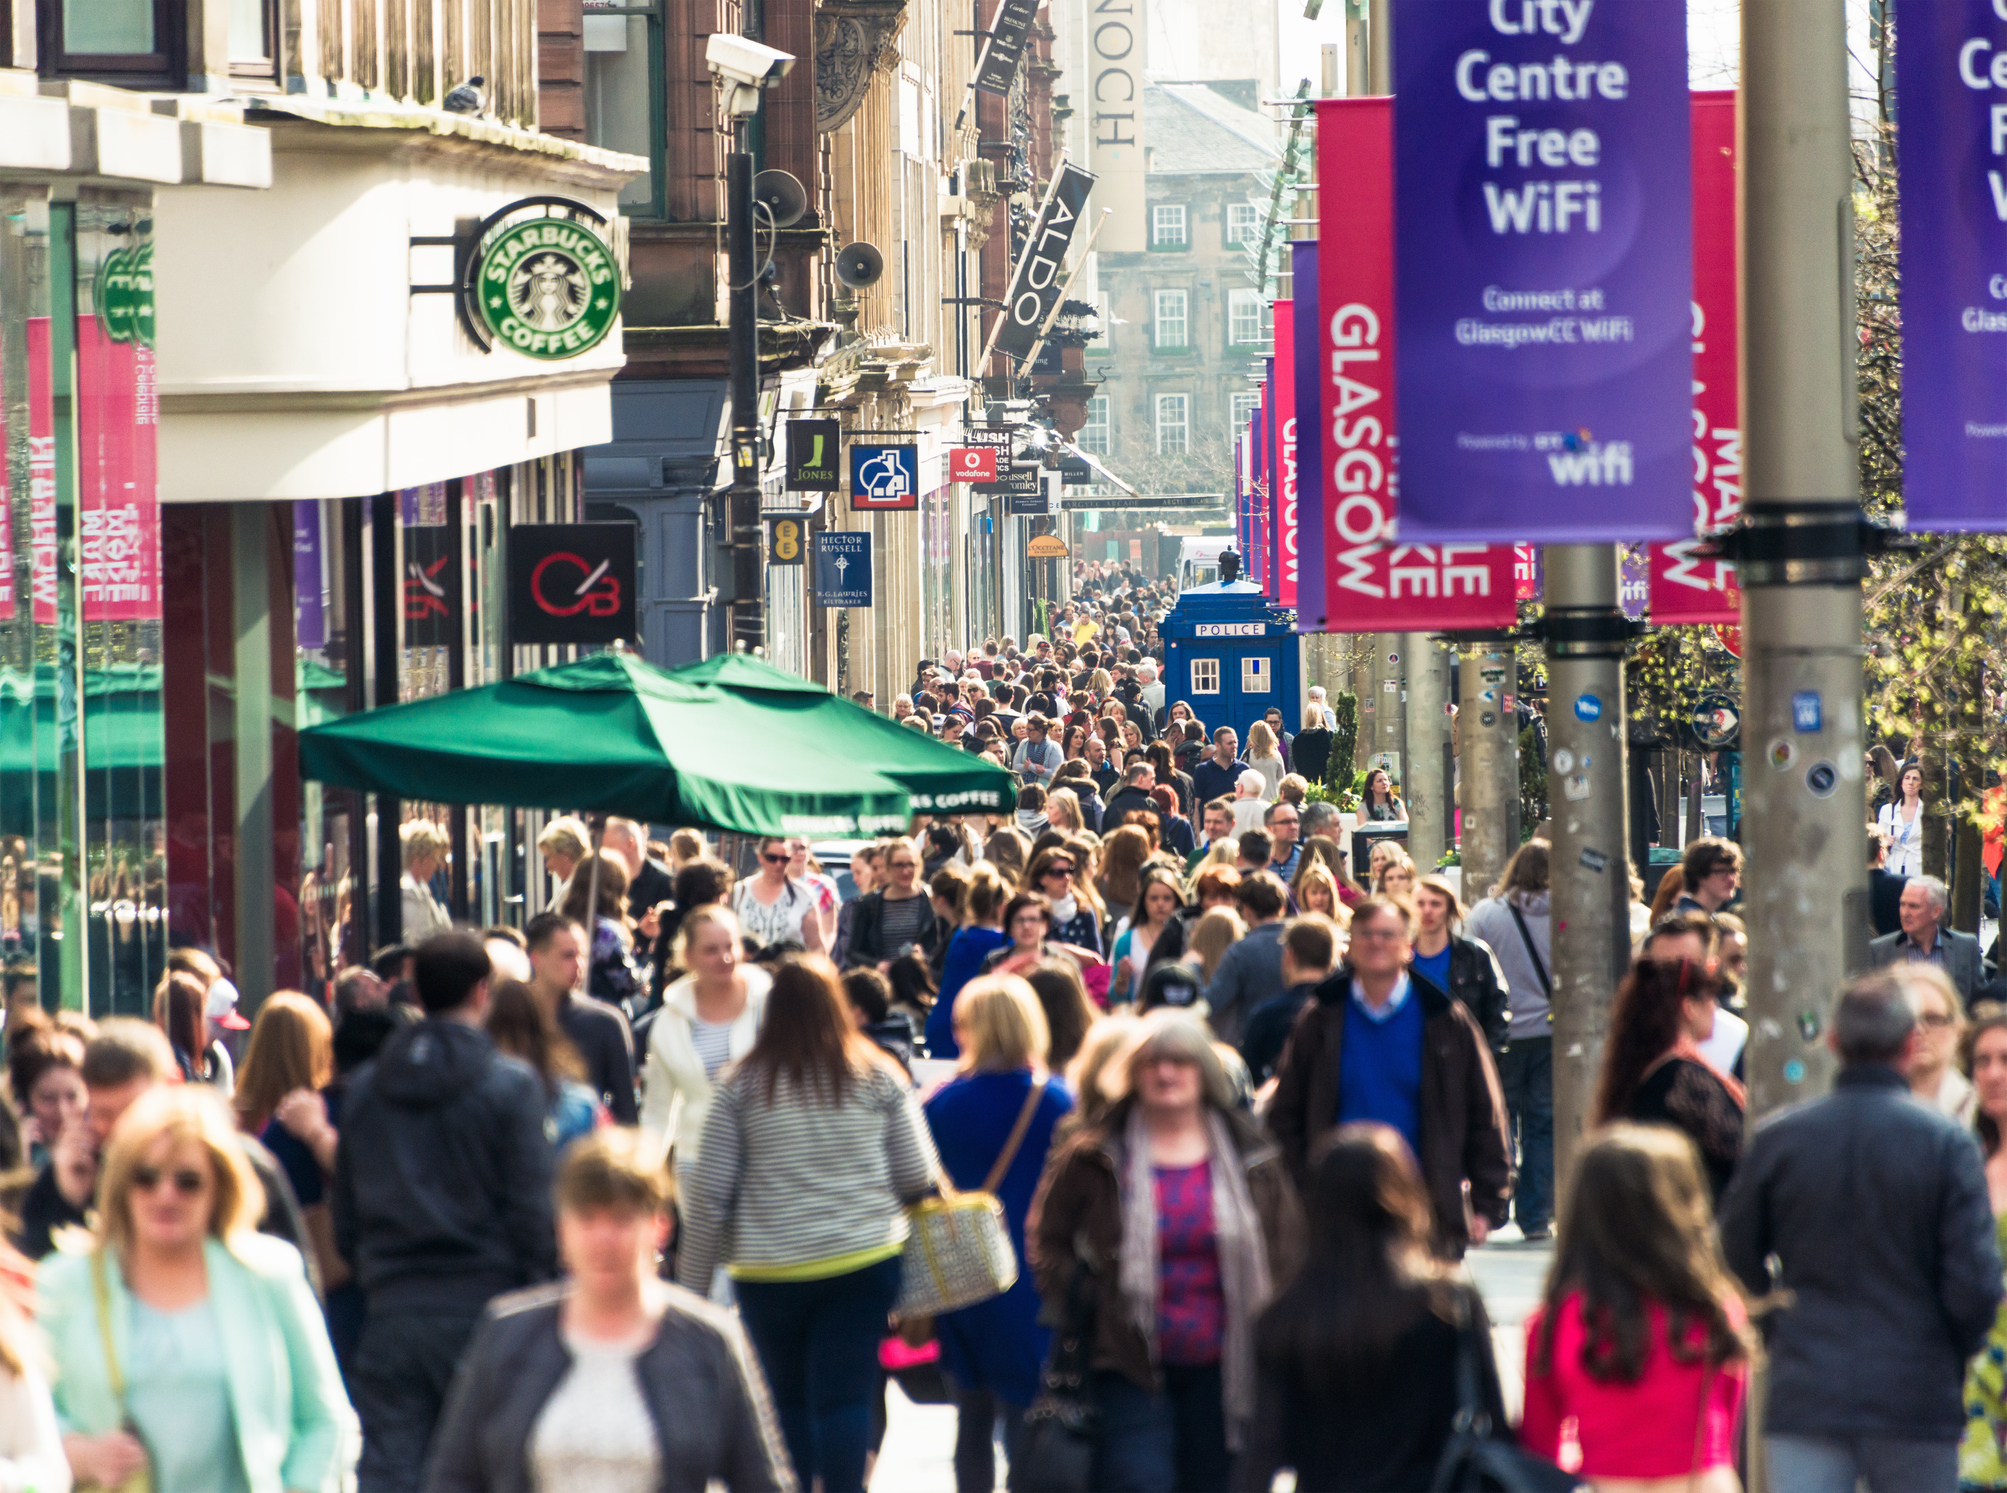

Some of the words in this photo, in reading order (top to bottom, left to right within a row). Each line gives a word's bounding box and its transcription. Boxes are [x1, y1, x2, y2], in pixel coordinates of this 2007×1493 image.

[1488, 0, 1595, 43] City
[1456, 49, 1629, 101] Centre
[1486, 115, 1600, 167] Free
[1482, 181, 1602, 234] WiFi
[486, 226, 612, 285] STARBUCKS
[1015, 195, 1074, 326] ALDO
[1482, 285, 1575, 312] Connect
[1578, 287, 1605, 311] at
[500, 316, 596, 353] COFFEE
[967, 432, 1009, 444] LUSH
[1331, 303, 1386, 599] GLASGOW
[793, 468, 833, 481] JONES
[1008, 472, 1032, 481] ussell
[1547, 440, 1634, 486] wifi
[821, 535, 862, 544] HECTOR
[1200, 625, 1259, 635] POLICE
[1576, 700, 1599, 715] Yes
[935, 791, 1000, 808] COFFEE
